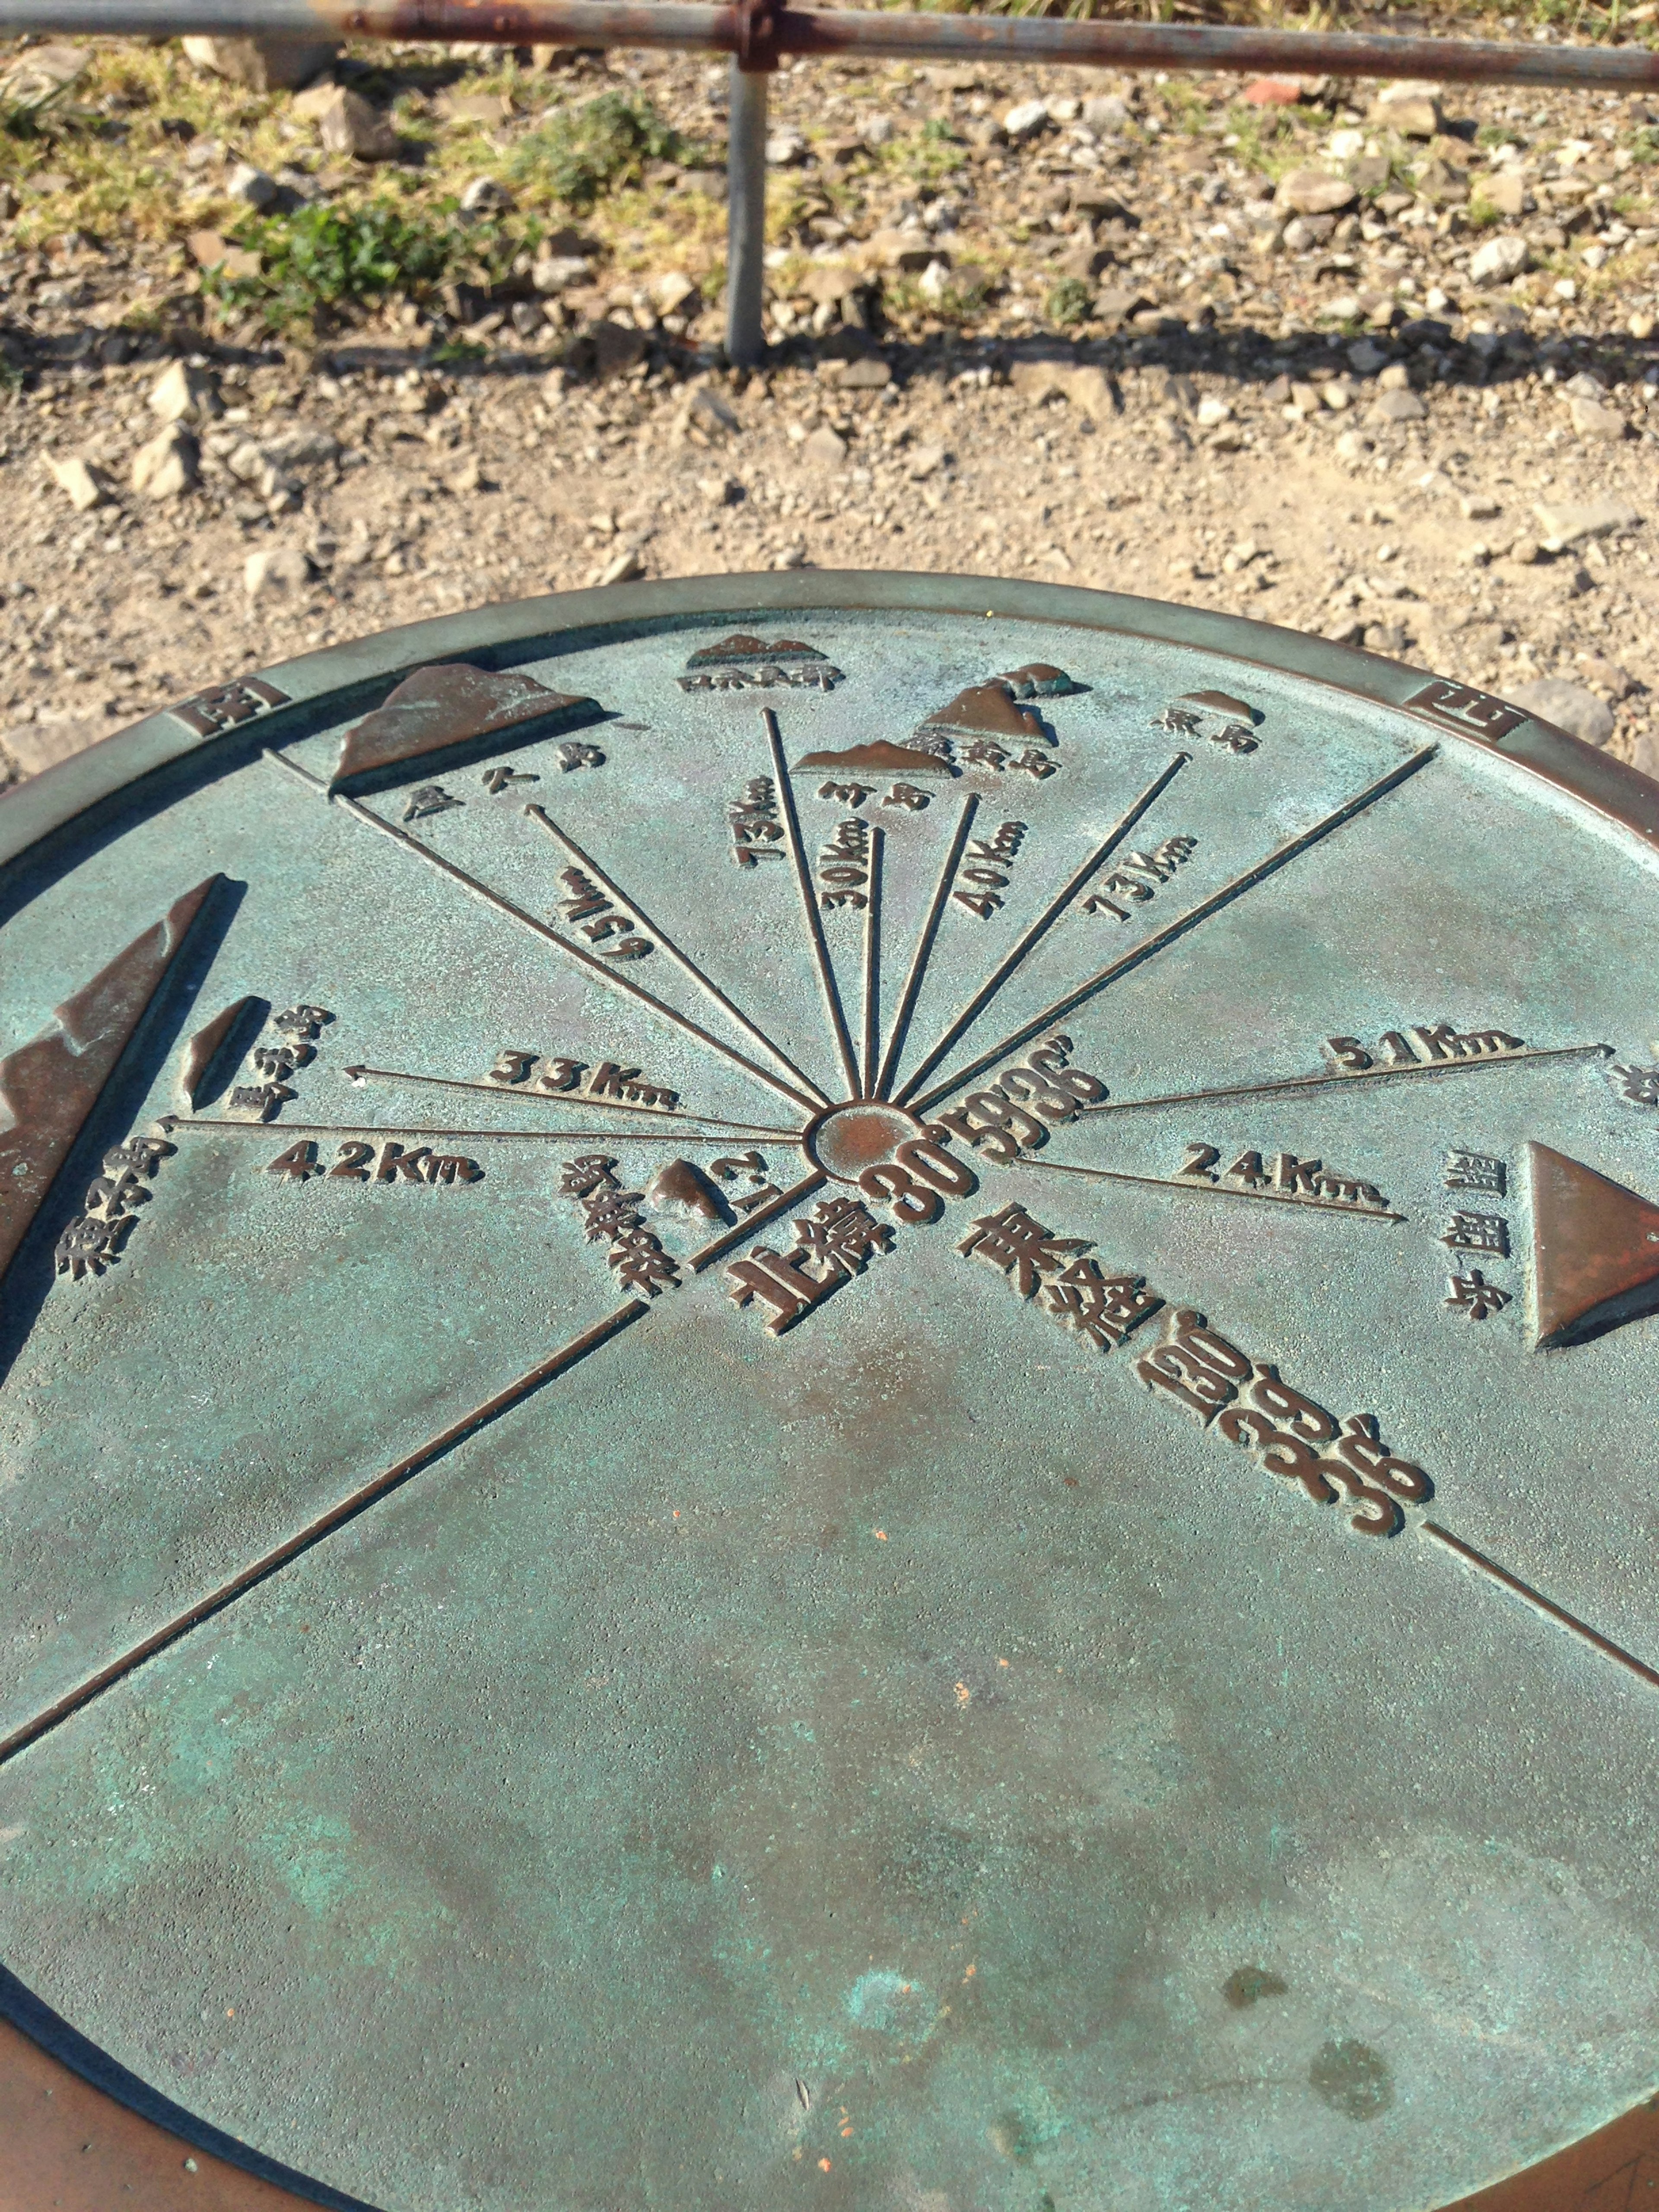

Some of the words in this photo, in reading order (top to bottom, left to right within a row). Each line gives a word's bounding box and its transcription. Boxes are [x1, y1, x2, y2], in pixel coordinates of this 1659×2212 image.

[1148, 701, 1262, 754] 黒島
[1400, 678, 1532, 744] 西
[731, 776, 786, 869] 73Km
[817, 780, 936, 810] 竹島
[819, 817, 869, 911] 30Km
[953, 821, 1028, 921] 40Km
[1079, 834, 1198, 921] 73Km
[557, 865, 655, 960] 65Km
[488, 1049, 683, 1110] 33Km
[1327, 1023, 1525, 1071] 51Km
[264, 1139, 486, 1185] 42Km
[1176, 1141, 1391, 1209] 24Km
